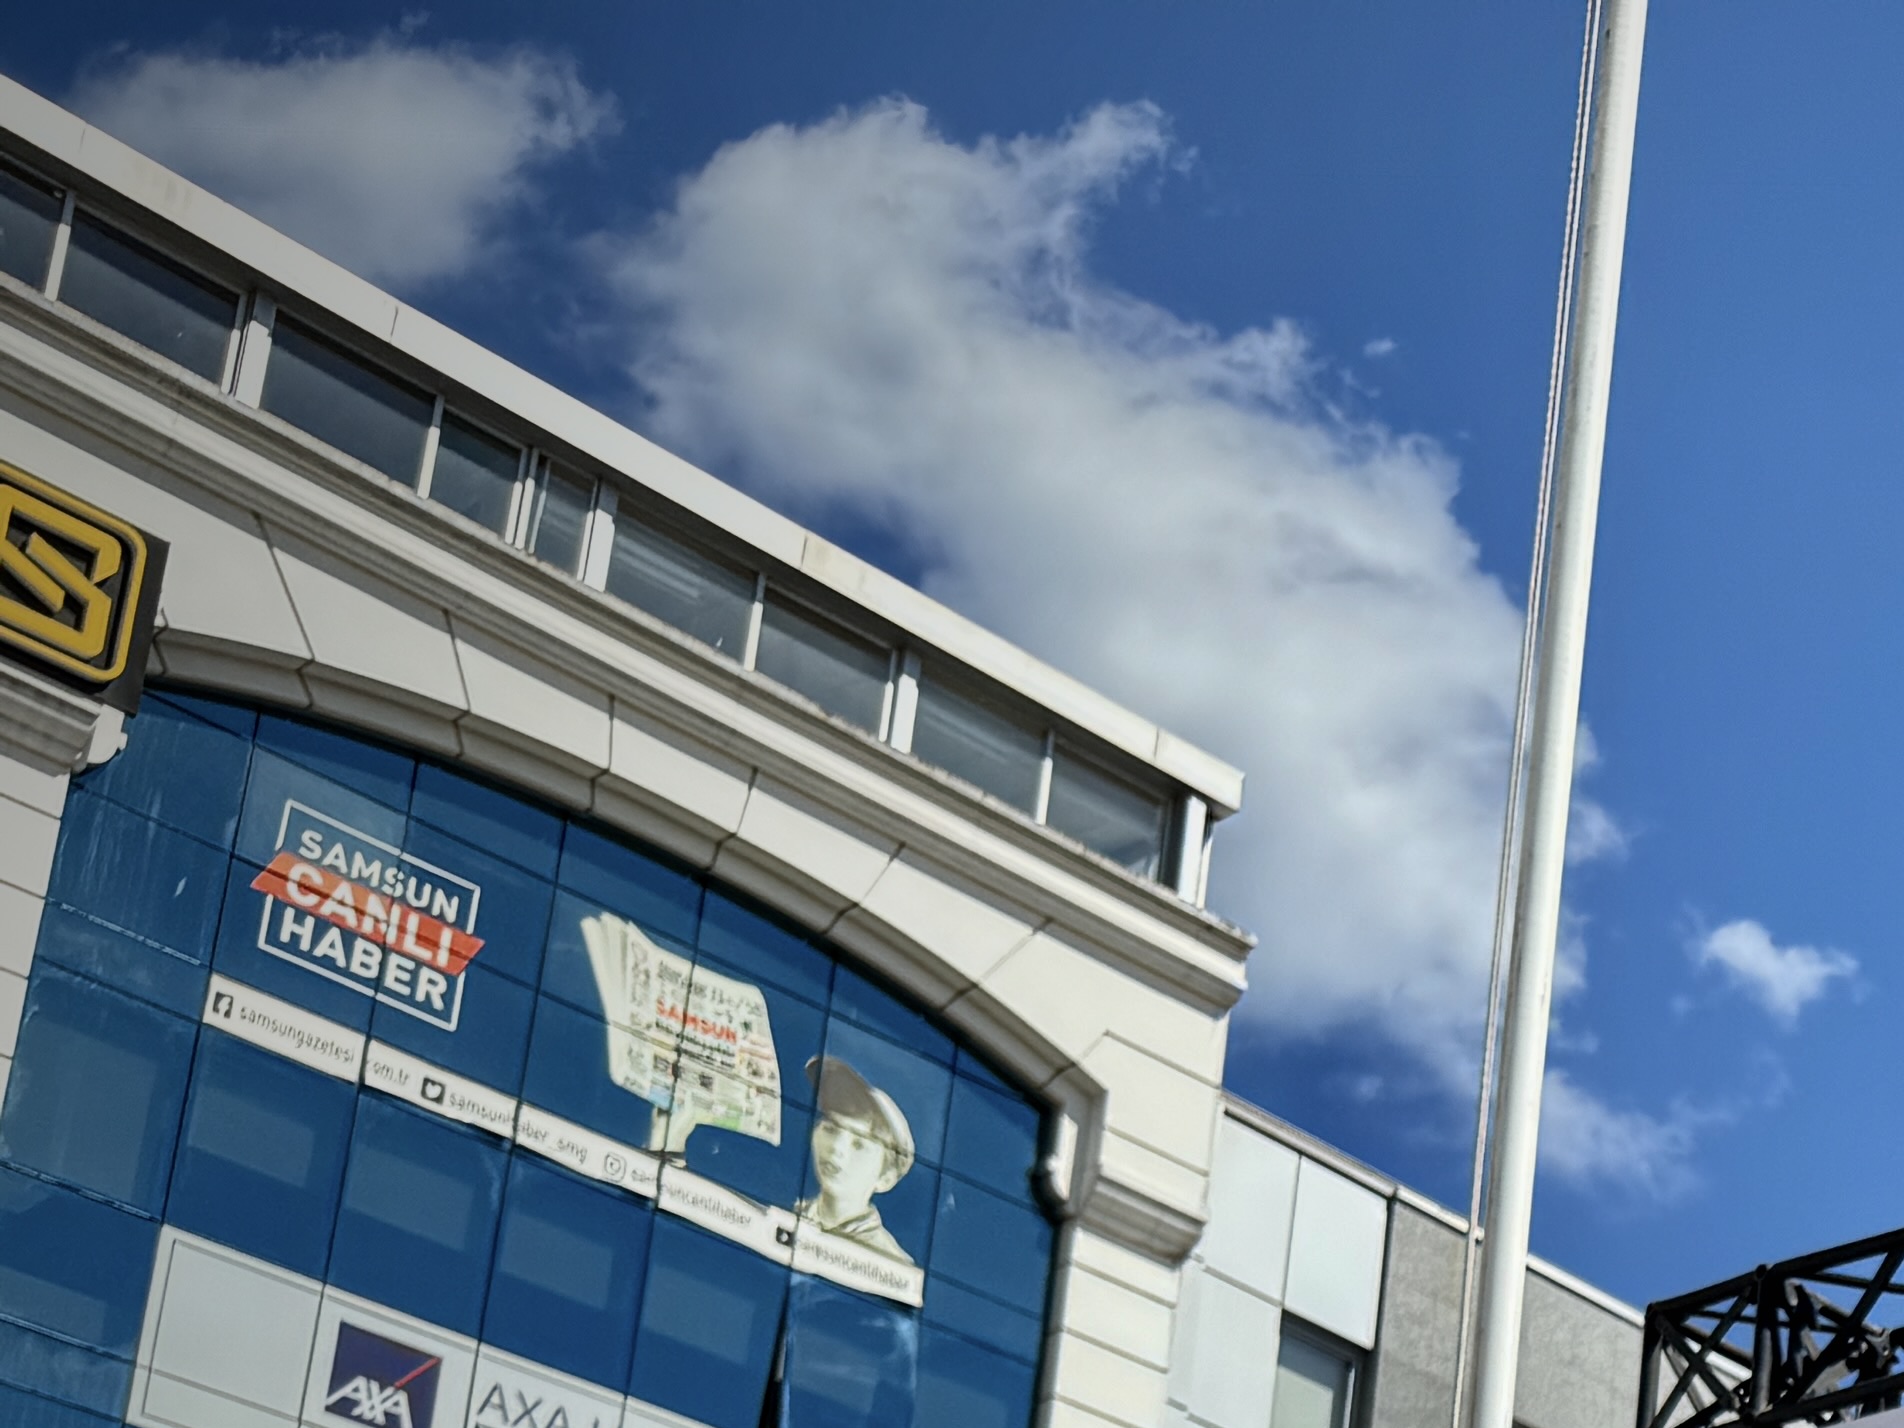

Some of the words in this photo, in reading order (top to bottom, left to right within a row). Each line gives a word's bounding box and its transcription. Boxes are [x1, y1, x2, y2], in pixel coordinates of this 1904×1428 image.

[286, 862, 453, 968] CANLI
[298, 829, 460, 924] SAMSUN
[279, 906, 448, 1012] HABER
